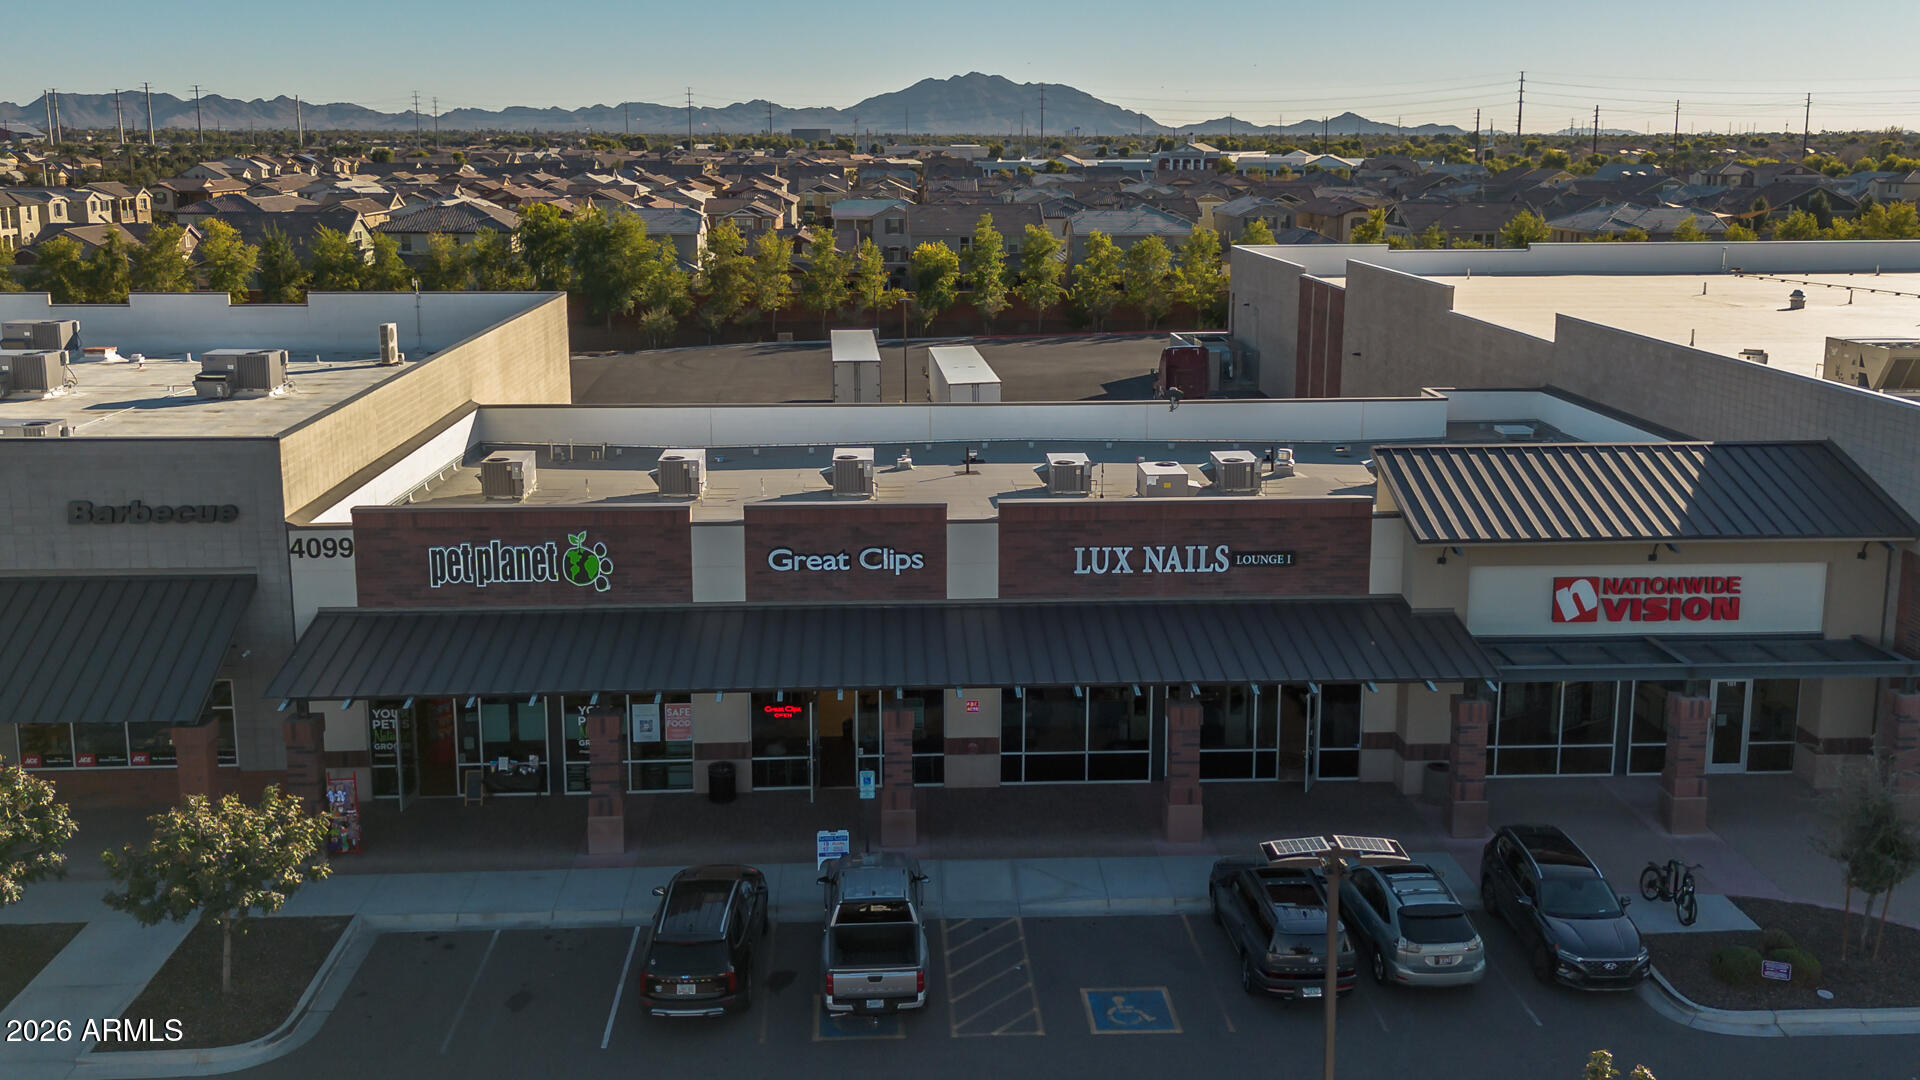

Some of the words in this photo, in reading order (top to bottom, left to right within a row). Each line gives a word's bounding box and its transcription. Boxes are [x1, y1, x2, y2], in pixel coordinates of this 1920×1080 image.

[67, 499, 239, 525] Barbecue
[289, 536, 354, 560] 4099
[1073, 546, 1134, 574] LUX
[1142, 544, 1230, 574] NAILS
[1236, 554, 1285, 566] LOUNGE
[767, 547, 851, 572] Great
[858, 547, 925, 576] Clips
[1601, 576, 1742, 595] NATIONWIDE
[1600, 596, 1741, 622] VISION
